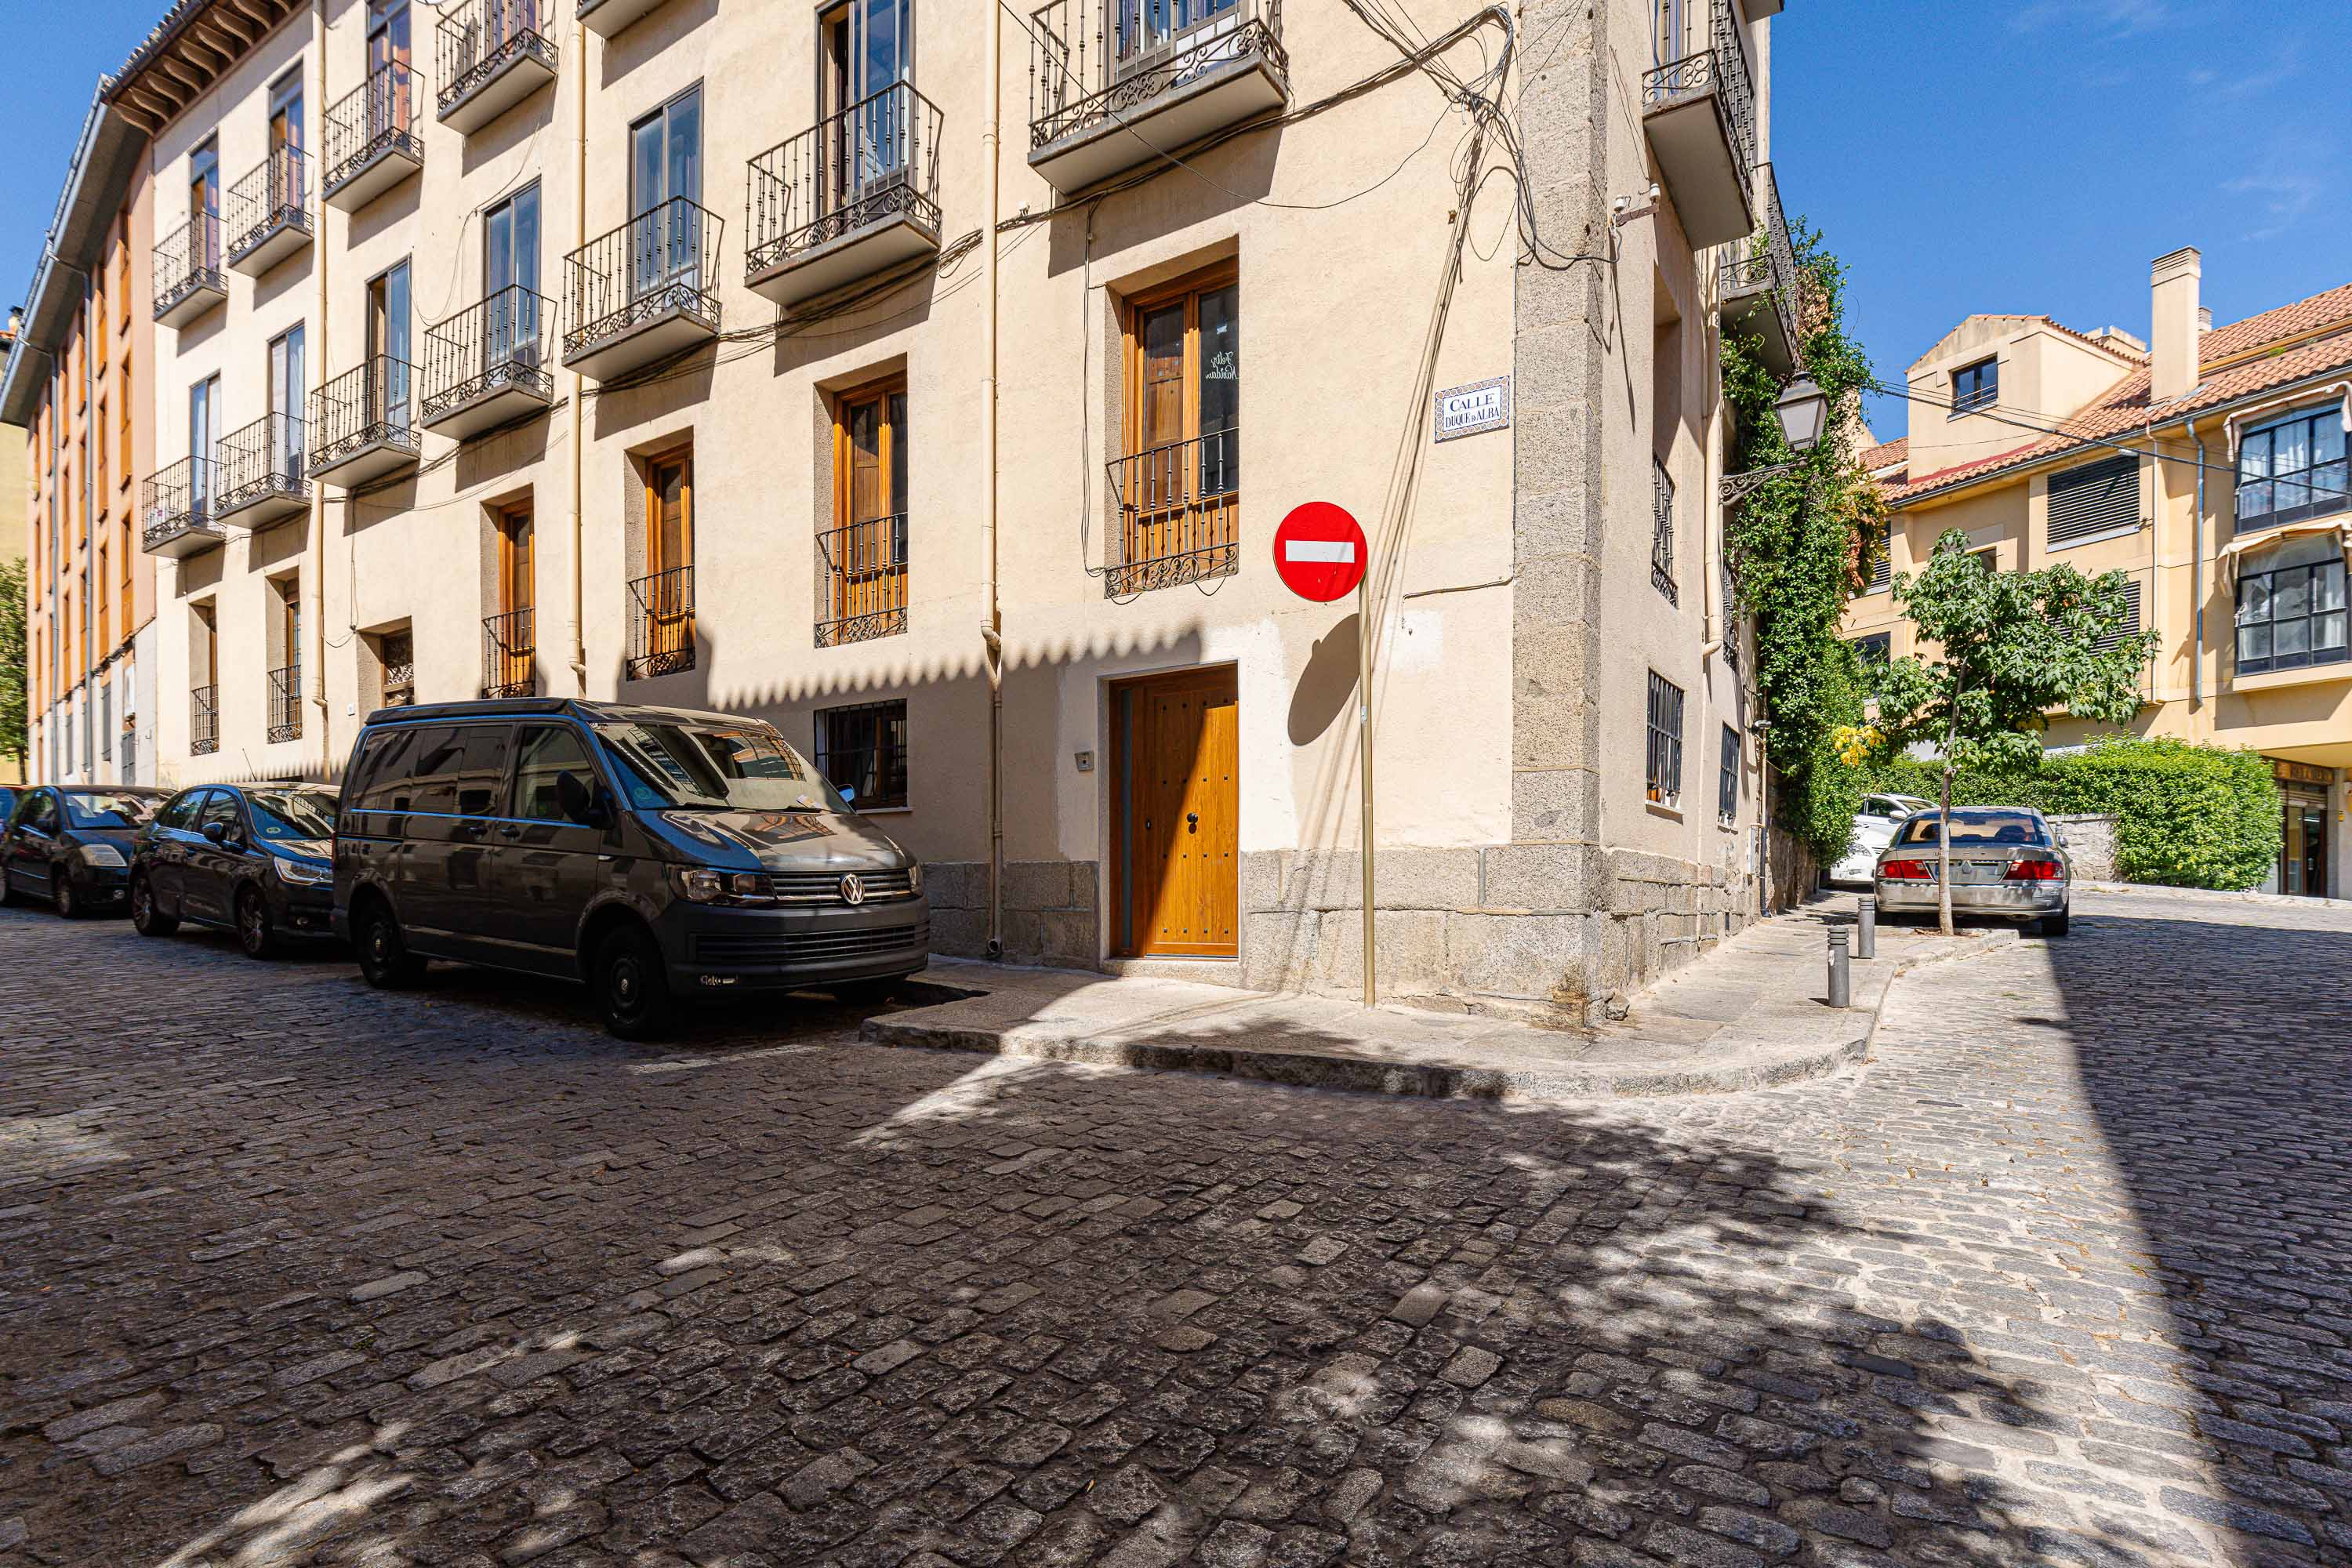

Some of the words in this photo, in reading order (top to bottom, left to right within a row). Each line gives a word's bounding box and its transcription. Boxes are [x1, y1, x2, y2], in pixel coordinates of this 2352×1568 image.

[1450, 393, 1494, 412] CALLE
[1446, 412, 1471, 427] DUQUE
[1477, 406, 1499, 421] ALBA
